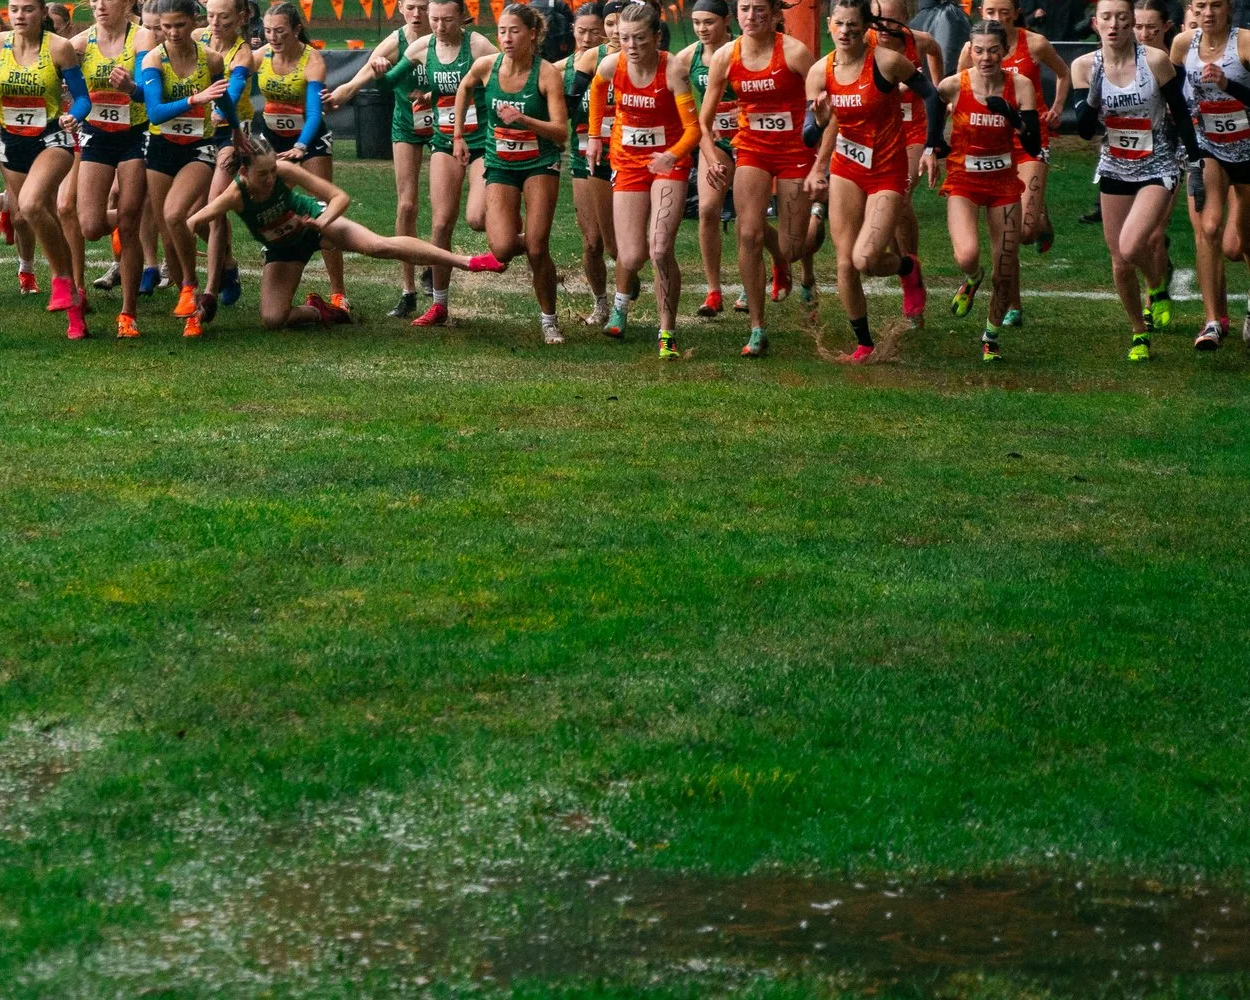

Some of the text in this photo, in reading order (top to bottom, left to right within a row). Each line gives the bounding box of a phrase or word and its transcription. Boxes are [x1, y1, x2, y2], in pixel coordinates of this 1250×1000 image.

[9, 72, 38, 84] BRUCE
[434, 71, 461, 84] FOREST
[2, 83, 47, 97] TOWNSHIP
[439, 83, 457, 94] PARK
[741, 79, 776, 92] DENVER
[622, 93, 656, 109] DENVER
[831, 93, 862, 108] DENVER
[1106, 93, 1145, 109] CARMEL
[15, 113, 35, 125] 47
[100, 109, 119, 121] 48
[970, 112, 1005, 128] DENVER
[172, 123, 193, 134] 45
[276, 119, 295, 130] 50
[757, 118, 786, 130] 139
[1215, 119, 1237, 133] 56
[631, 133, 657, 146] 141
[1120, 135, 1139, 149] 57
[843, 143, 866, 164] 140
